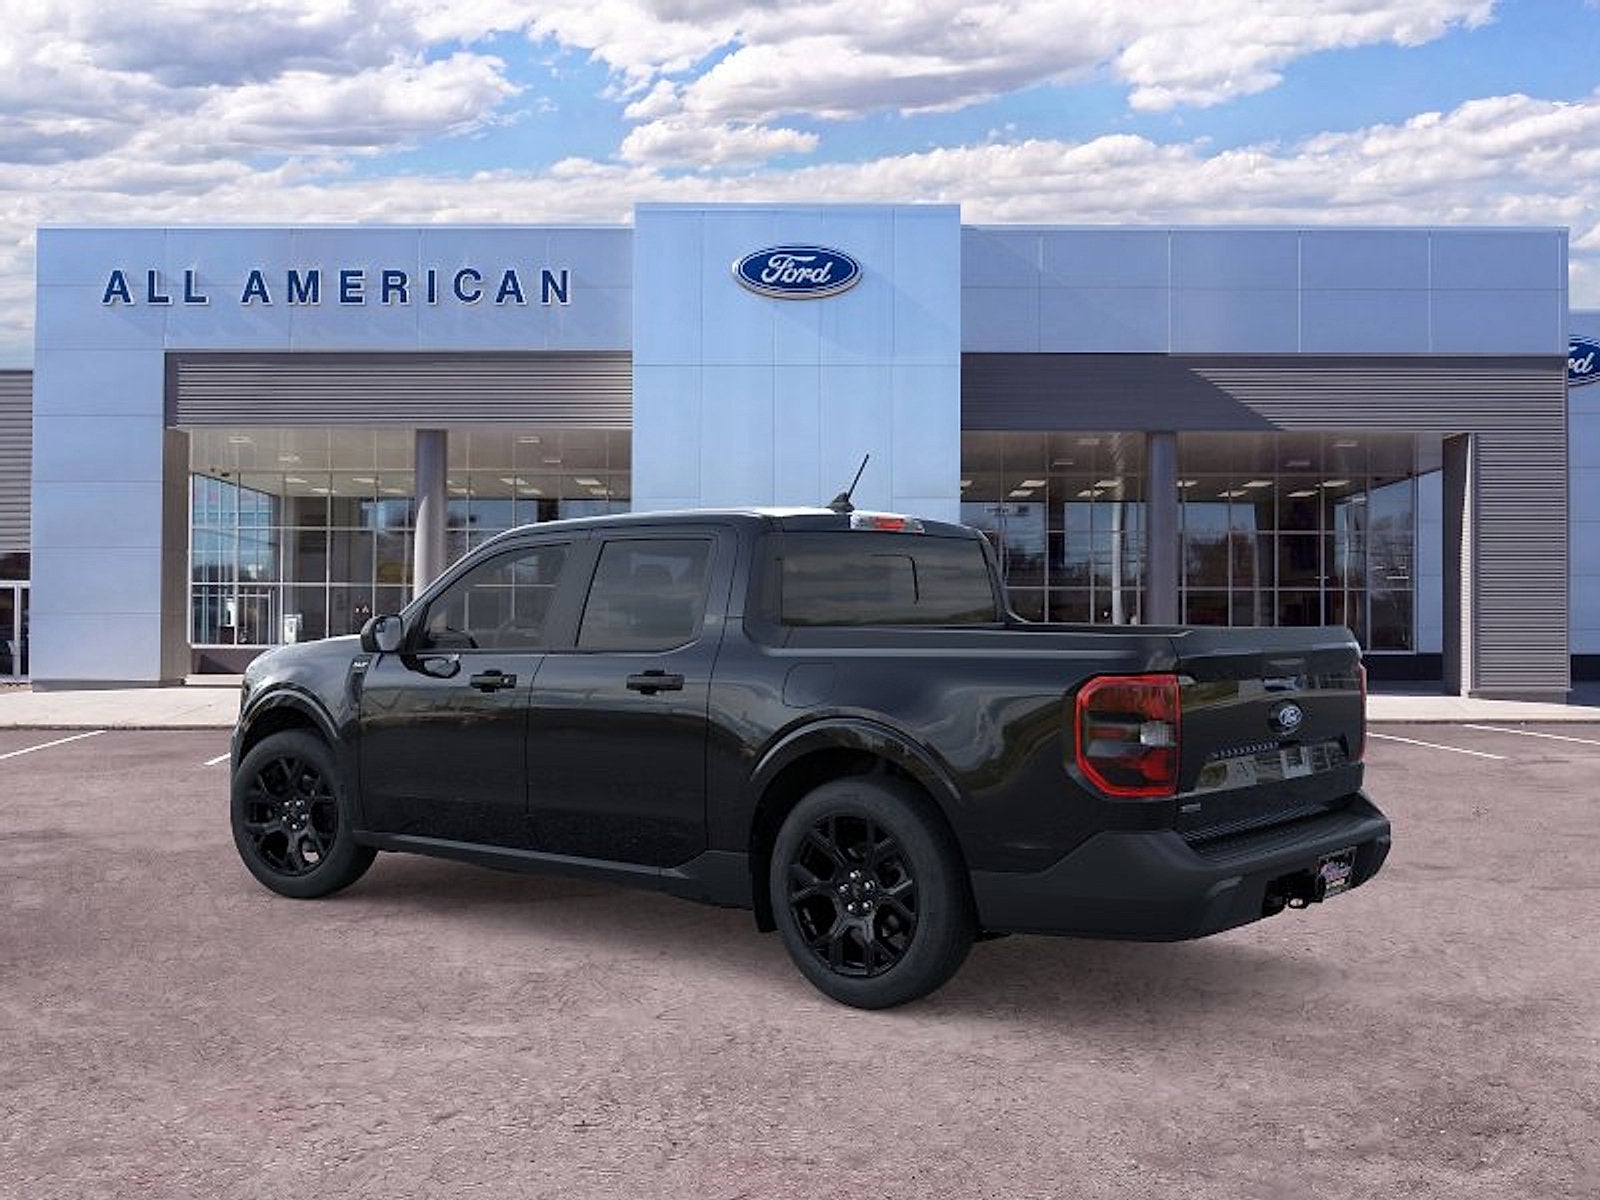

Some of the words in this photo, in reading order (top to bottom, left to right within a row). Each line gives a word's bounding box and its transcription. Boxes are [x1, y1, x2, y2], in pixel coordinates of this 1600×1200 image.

[761, 253, 834, 283] Ford
[102, 268, 209, 306] ALL
[241, 267, 573, 306] AMERICAN
